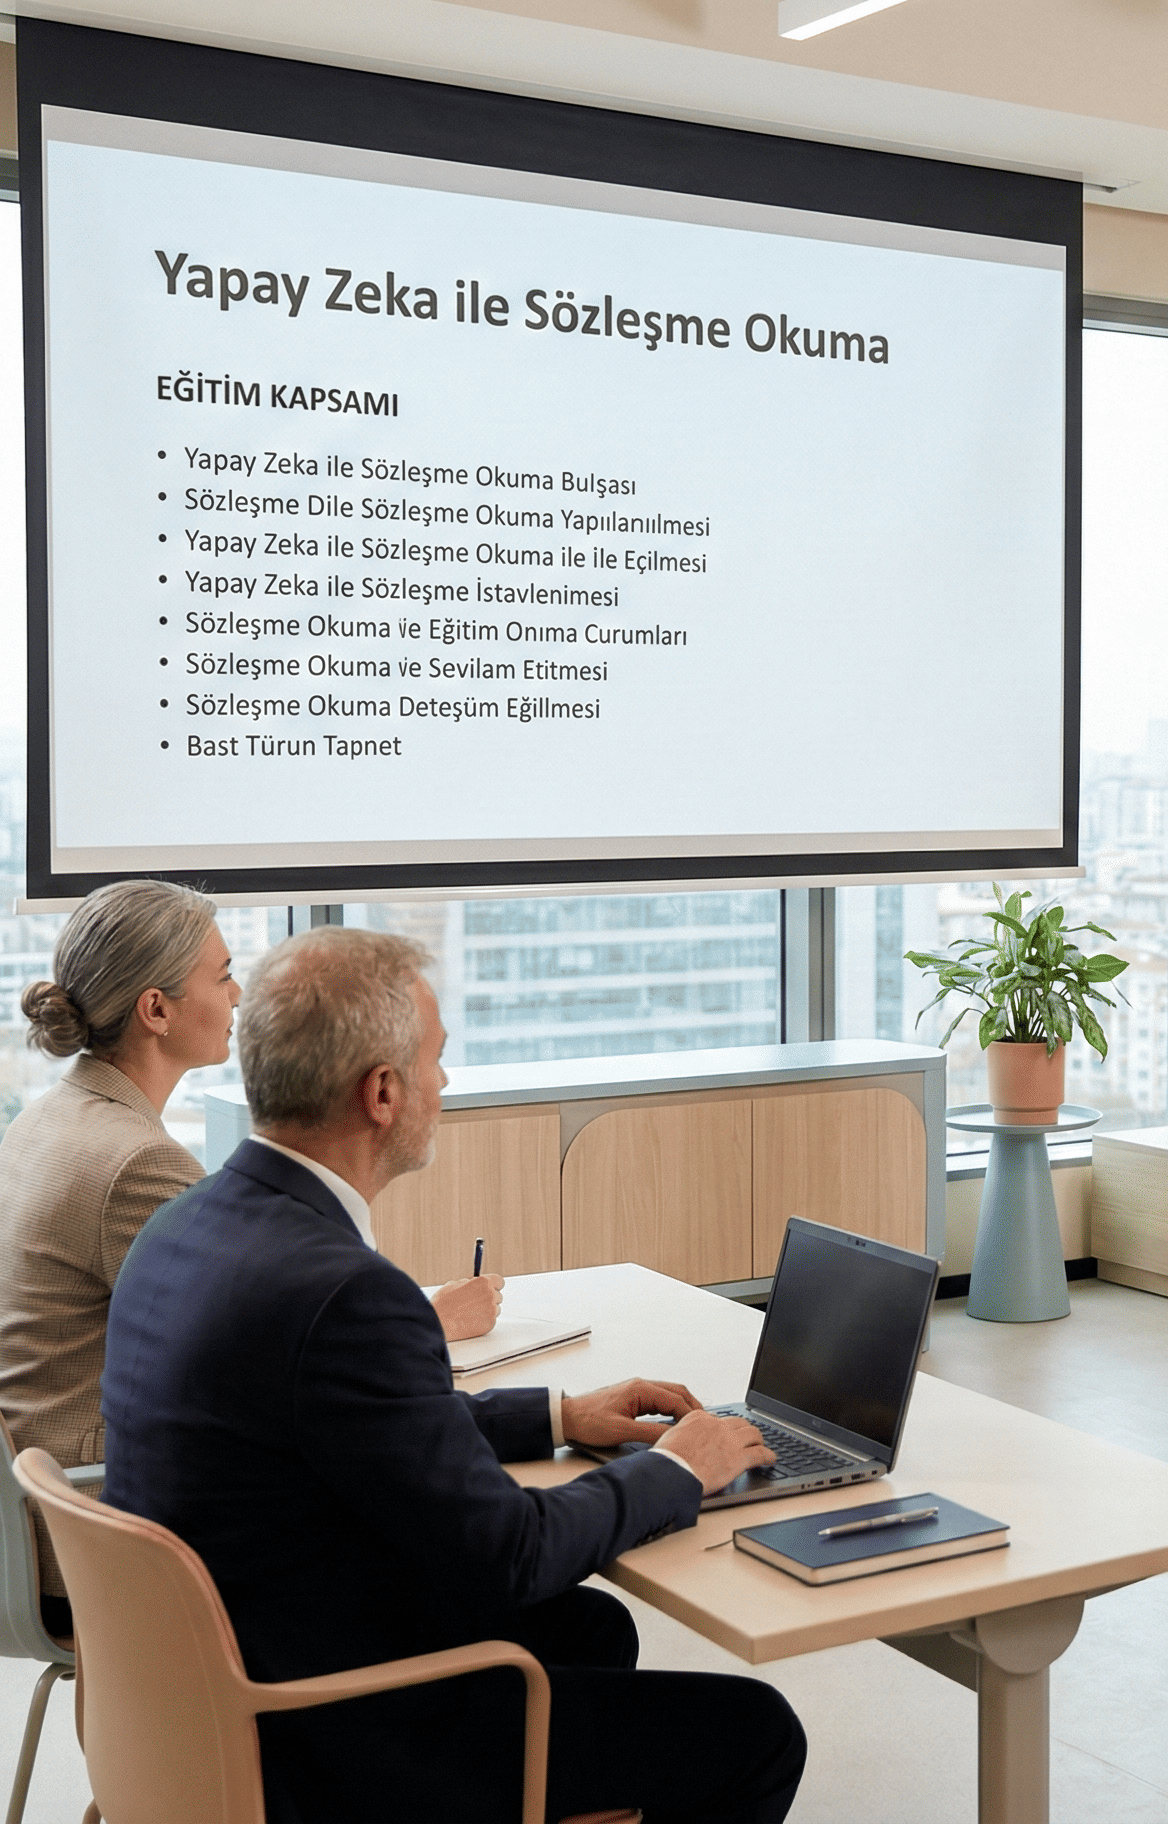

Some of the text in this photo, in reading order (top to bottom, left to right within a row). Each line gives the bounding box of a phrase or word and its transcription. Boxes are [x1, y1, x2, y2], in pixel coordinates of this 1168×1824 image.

[154, 249, 889, 364] Yapay Zeka ile Sözleşme Okuma
[157, 369, 398, 417] EĞİTİM KAPSAMI
[184, 446, 636, 499] Yapay Zeka ile Sözleşme Okuma Bulşası
[184, 487, 300, 519] Sözleşme
[308, 494, 354, 518] Dile
[361, 497, 469, 527] Sözleşme
[476, 503, 554, 529] Okuma
[184, 529, 257, 559] Yapay
[263, 532, 319, 556] Zeka
[327, 534, 354, 558] ile
[361, 537, 469, 567] Sözleşme
[476, 542, 554, 567] Okuma
[561, 546, 586, 568] ile
[625, 550, 707, 575] Eçilmesi
[184, 570, 619, 607] Yapay Zeka ile Sözleşme İstavlenimesi
[185, 611, 300, 641] Sözleşme
[307, 614, 391, 638] Okuma
[429, 617, 499, 645] Eğitim
[584, 623, 687, 646] Curumları
[186, 651, 300, 681] Sözleşme
[308, 654, 391, 678] Okuma
[428, 657, 515, 680] Sevilam
[523, 659, 608, 682] Etitmesi
[186, 692, 600, 723] Sözleşme Okuma Deteşüm Eğillmesi
[187, 734, 402, 761] Bast Türun Tapnet
